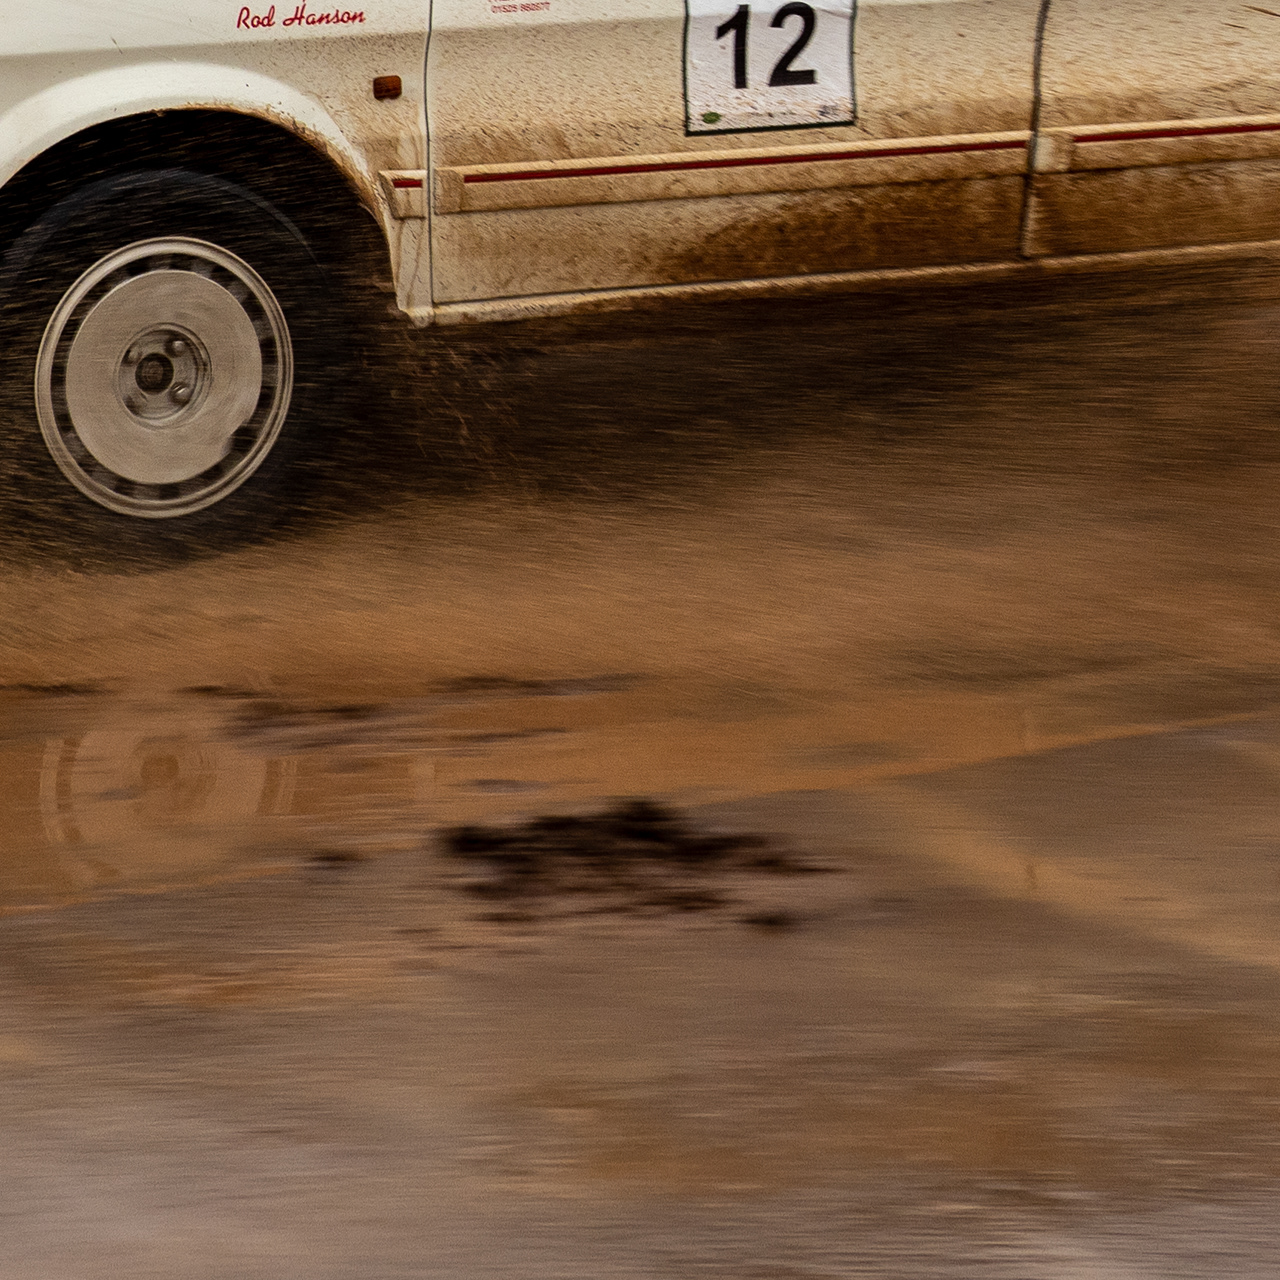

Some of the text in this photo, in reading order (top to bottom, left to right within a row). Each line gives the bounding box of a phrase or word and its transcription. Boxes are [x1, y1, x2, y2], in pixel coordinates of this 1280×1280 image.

[236, 3, 367, 29] Rod Hanson
[716, 1, 817, 89] 12
